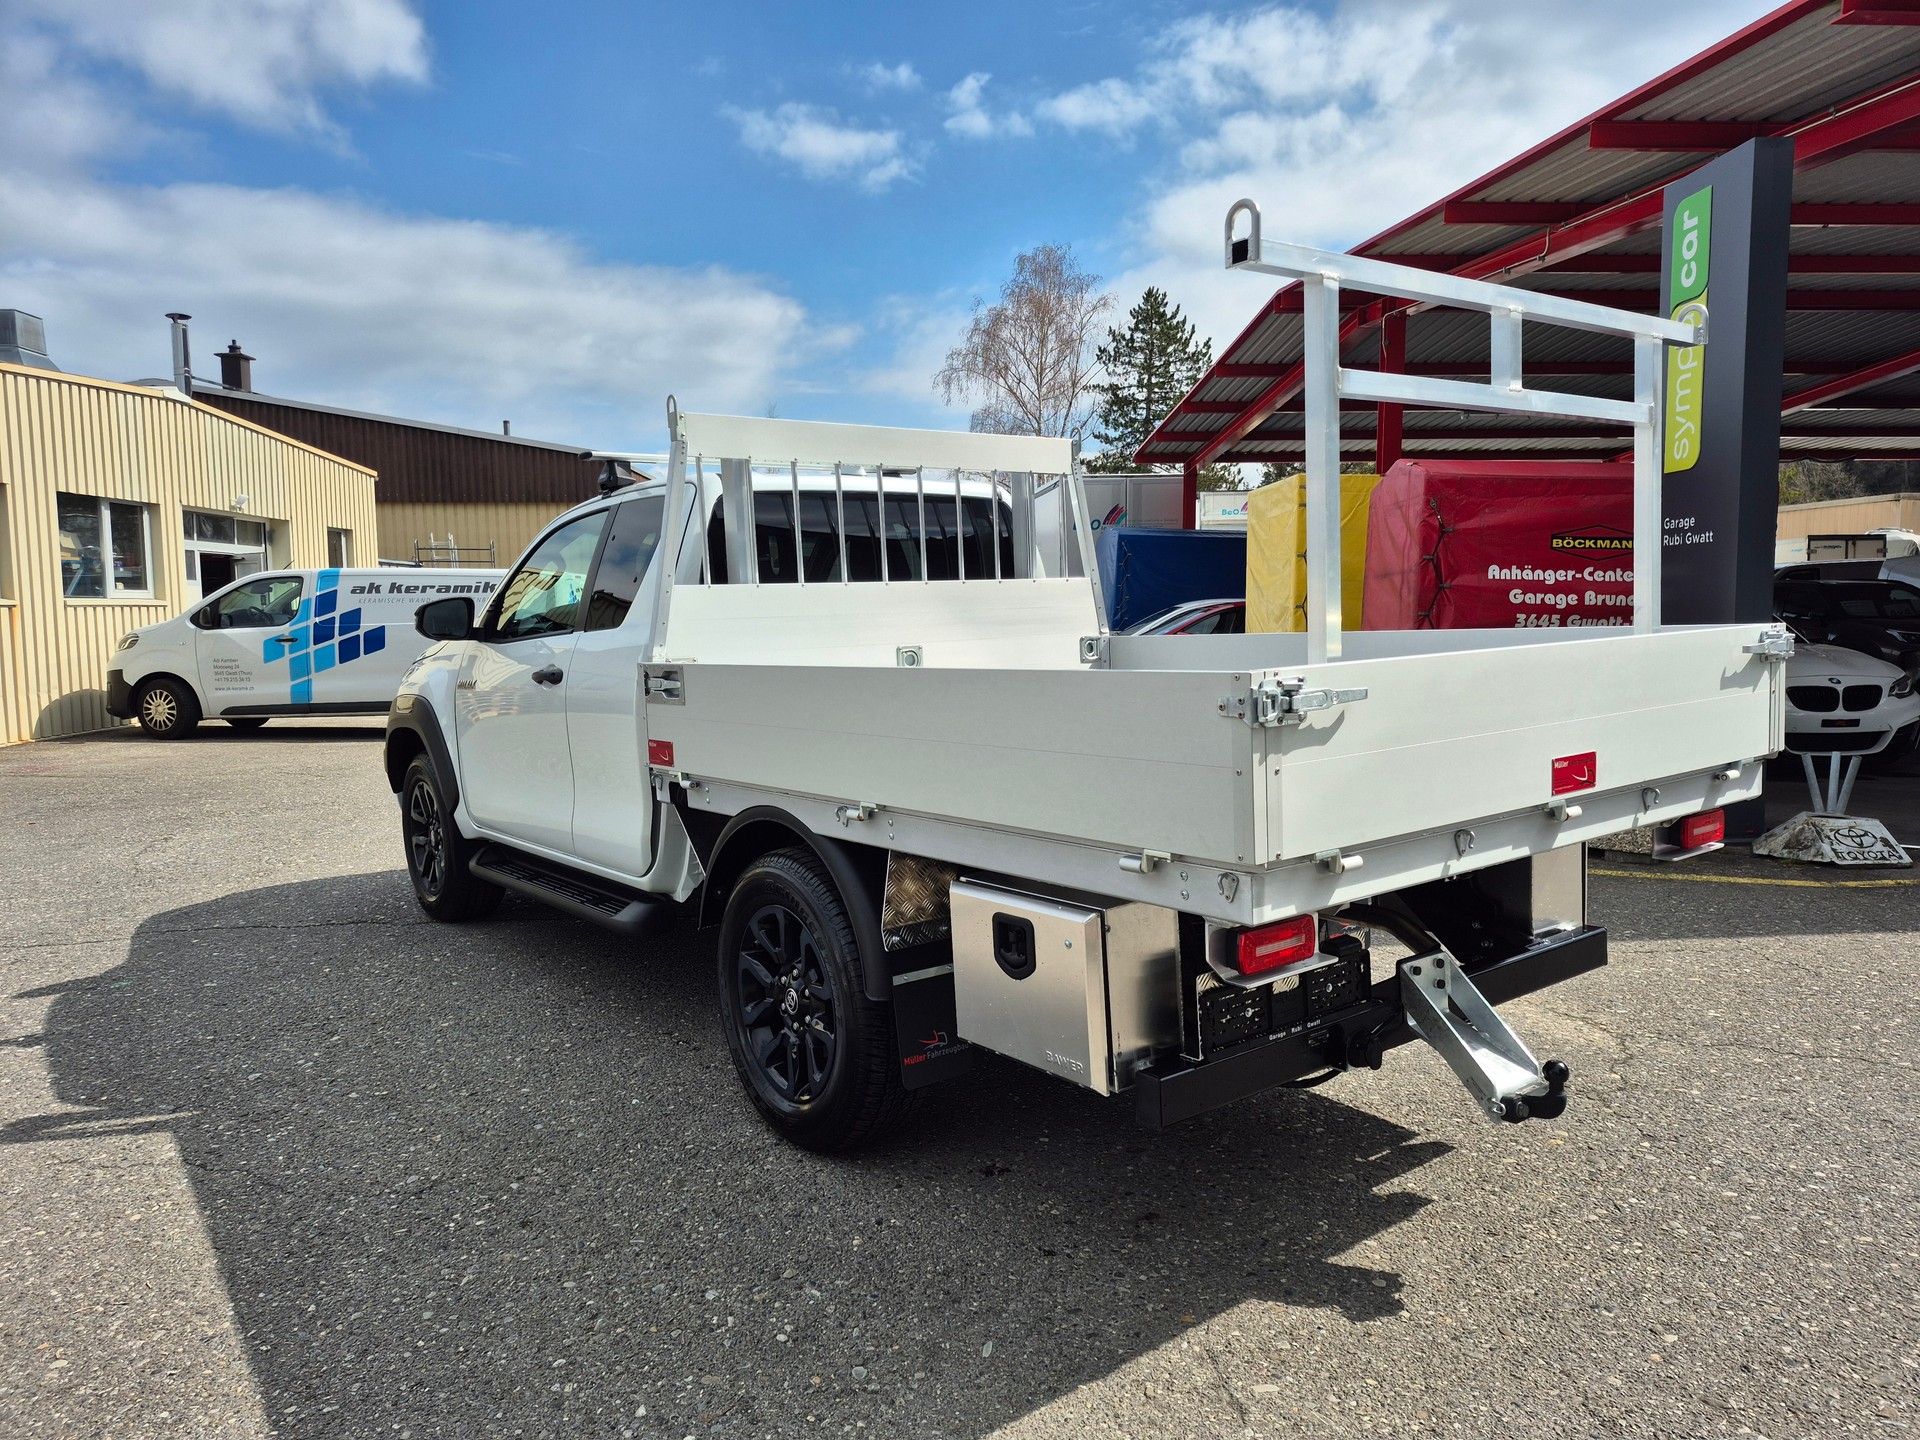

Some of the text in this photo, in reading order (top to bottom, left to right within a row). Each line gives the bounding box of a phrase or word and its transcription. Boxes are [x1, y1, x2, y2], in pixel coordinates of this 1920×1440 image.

[1680, 209, 1698, 288] car
[1663, 516, 1695, 530] Garage
[1552, 537, 1633, 549] BÖCKMAN
[1663, 530, 1714, 546] Rubi Gwatt
[1487, 564, 1634, 585] Anhänger-Cente
[350, 581, 498, 594] ak keramik
[1508, 588, 1579, 609] Garage
[1514, 613, 1561, 627] 3645
[1836, 850, 1900, 861] TOYOTA
